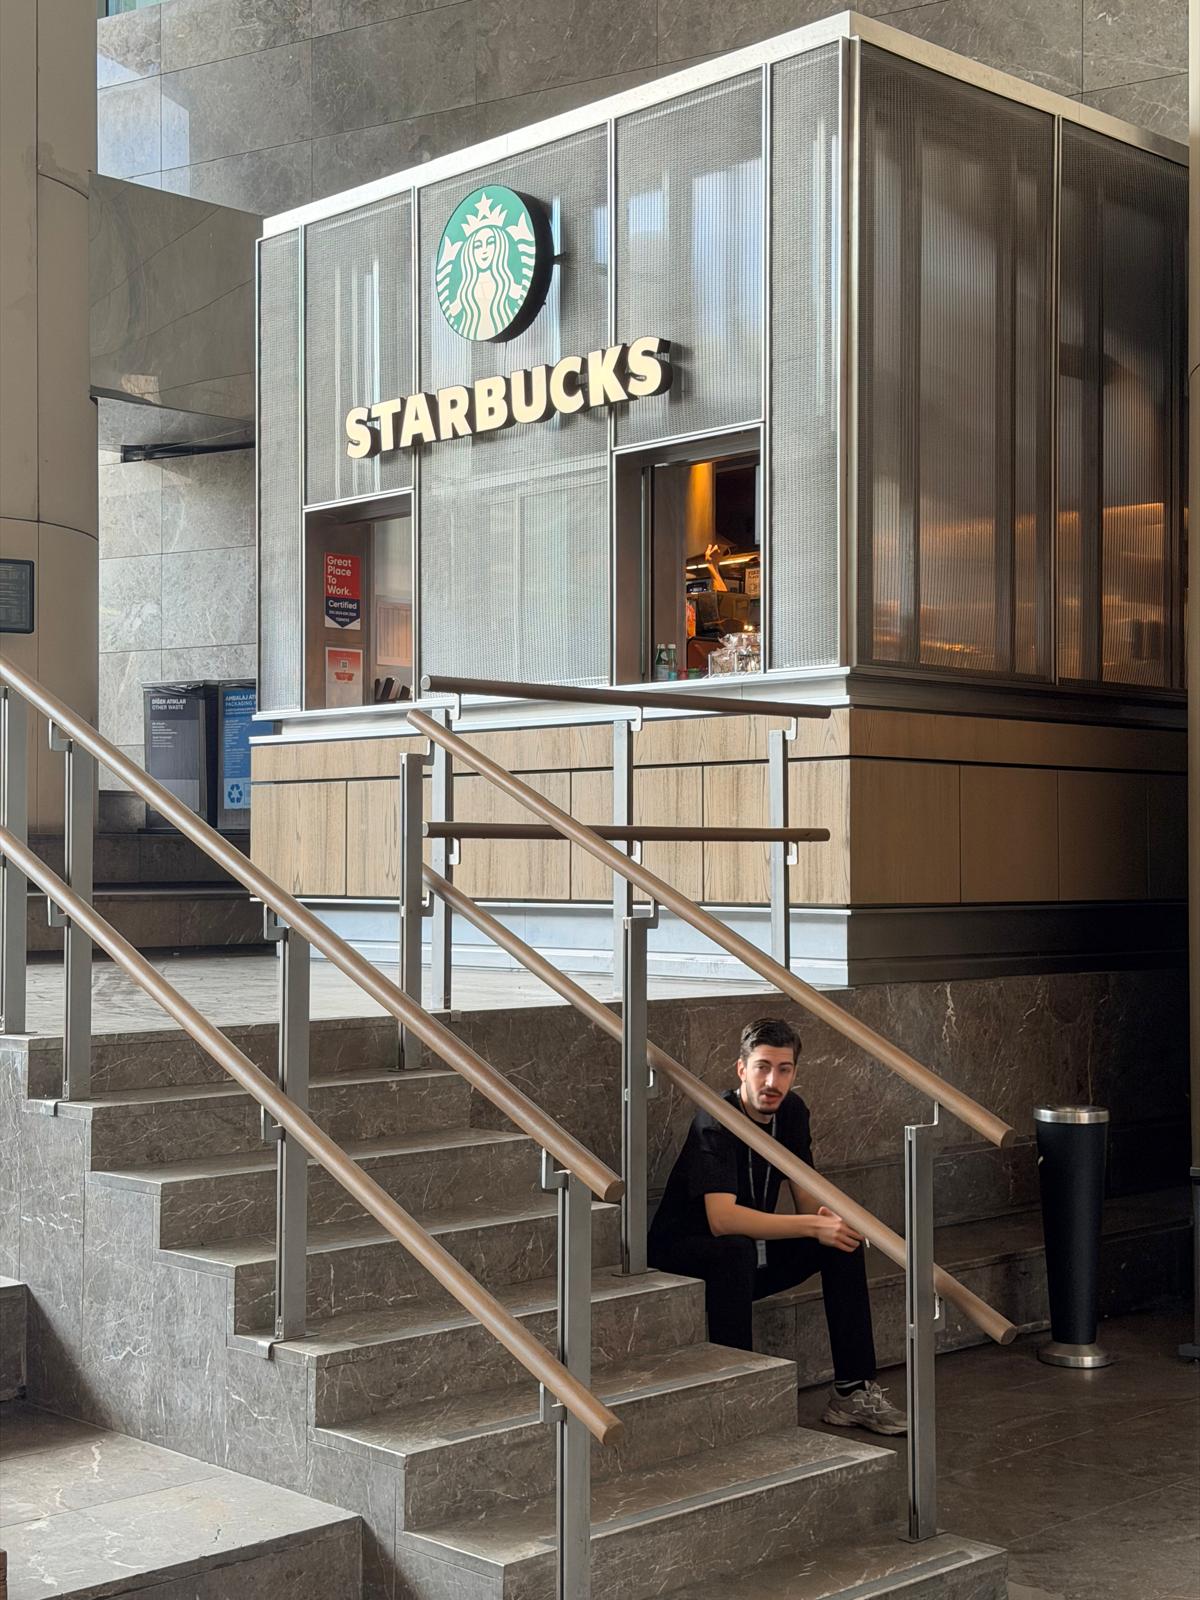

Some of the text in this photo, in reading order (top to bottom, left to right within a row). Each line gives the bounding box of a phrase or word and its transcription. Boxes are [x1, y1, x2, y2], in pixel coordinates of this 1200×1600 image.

[345, 336, 669, 460] STARBUCKS
[327, 555, 352, 566] Great
[327, 565, 352, 576] Place
[327, 575, 337, 585] To
[328, 600, 357, 610] Certified
